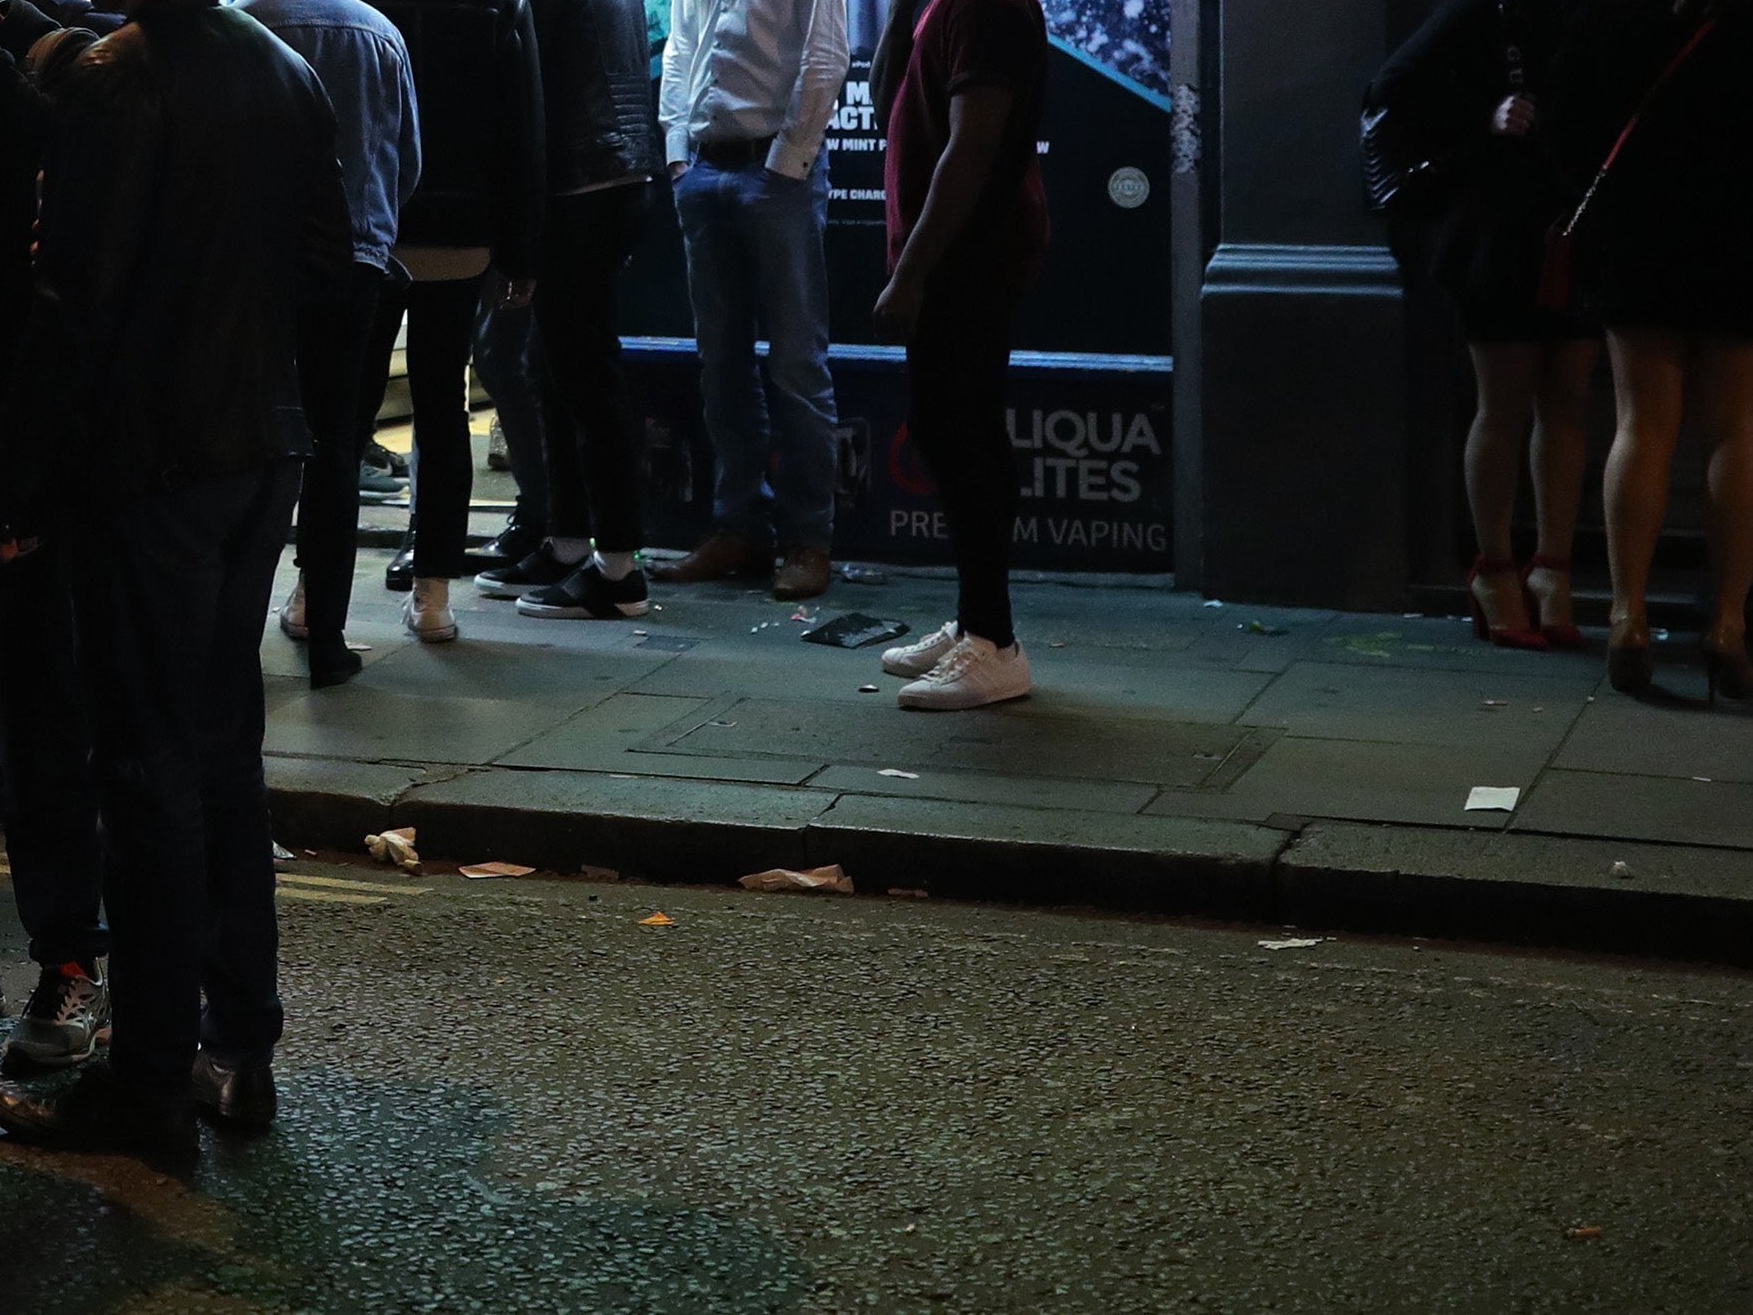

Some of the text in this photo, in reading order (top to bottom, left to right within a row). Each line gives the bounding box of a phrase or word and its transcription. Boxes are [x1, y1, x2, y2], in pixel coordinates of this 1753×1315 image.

[842, 138, 877, 152] MINT
[1004, 407, 1164, 458] LIQUA
[889, 509, 1167, 552] PREM VAPING
